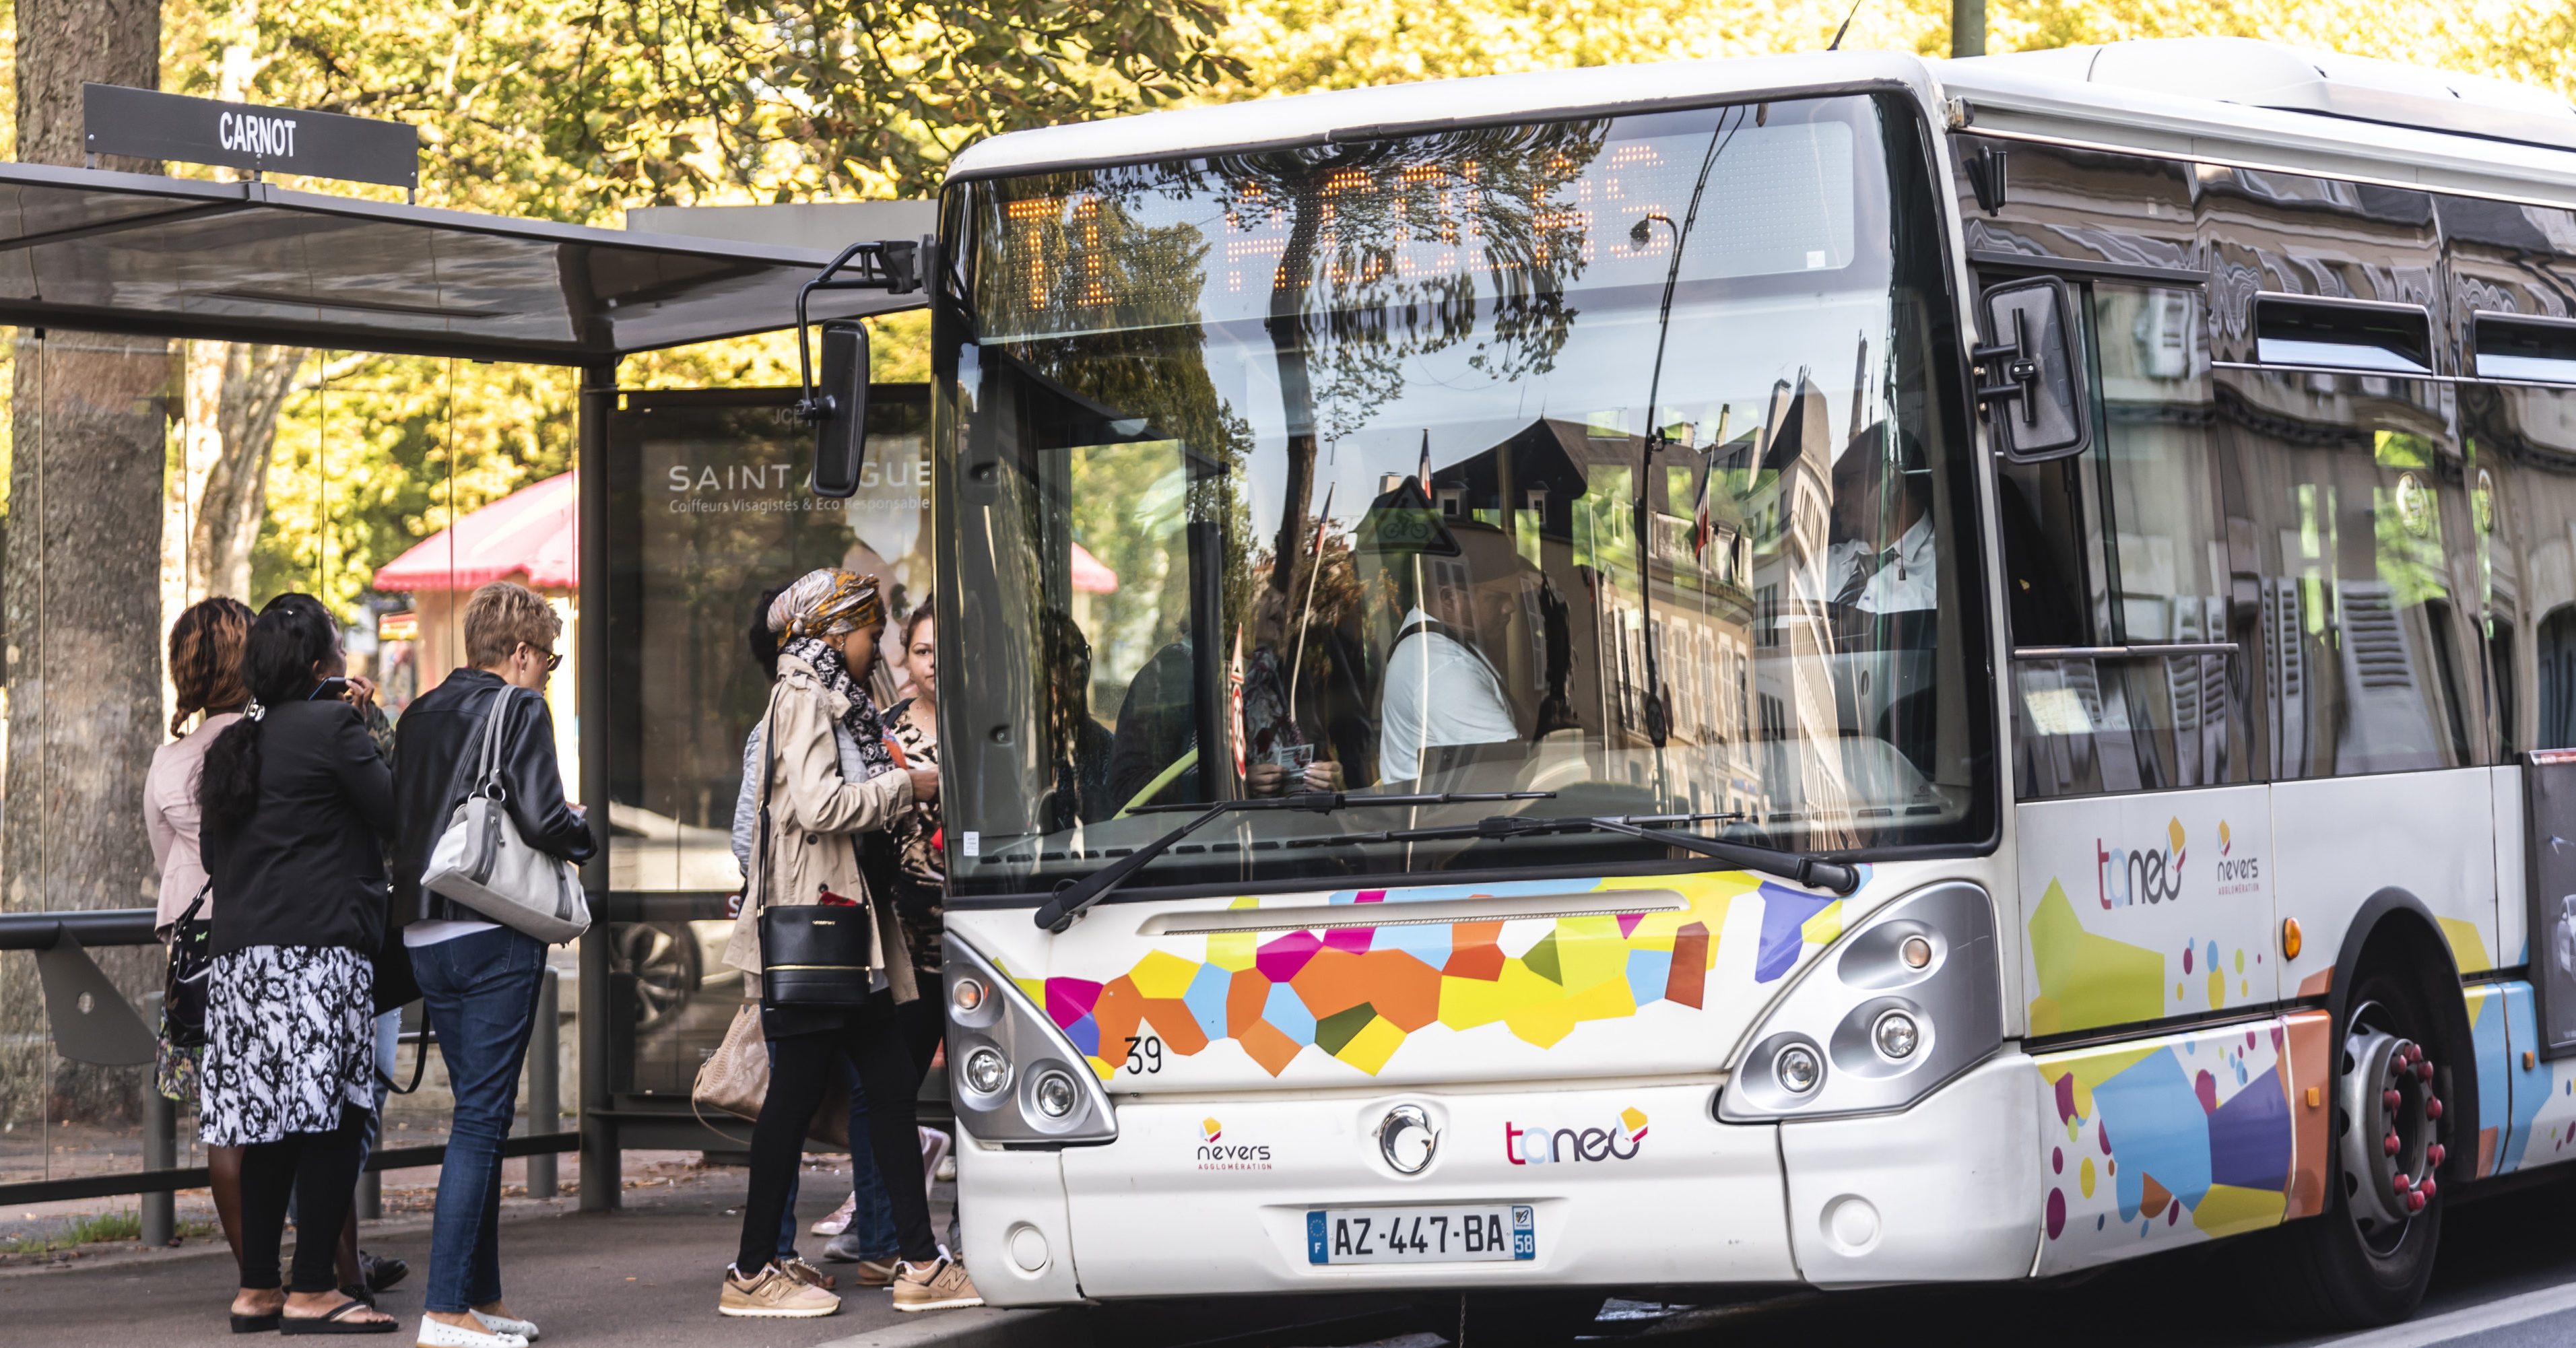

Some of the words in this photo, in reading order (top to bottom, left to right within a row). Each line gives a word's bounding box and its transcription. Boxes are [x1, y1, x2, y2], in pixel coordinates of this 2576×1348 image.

[220, 111, 296, 158] CARNOT
[1009, 196, 1113, 309] T1
[669, 464, 791, 491] SAINT
[669, 499, 729, 513] Coiffeurs
[732, 497, 799, 515] Visagistes
[802, 497, 812, 510] &
[816, 497, 840, 510] Eco
[2096, 832, 2183, 910] taneo
[2217, 858, 2258, 882] nevers
[1124, 1036, 1162, 1075] 39
[1197, 1146, 1271, 1160] nevers
[1506, 1114, 1643, 1165] taneo
[1198, 1162, 1272, 1170] AGGLOMÉRATION
[1314, 1242, 1321, 1254] F
[1335, 1214, 1505, 1256] AZ-447-BA
[1515, 1234, 1533, 1253] 58
